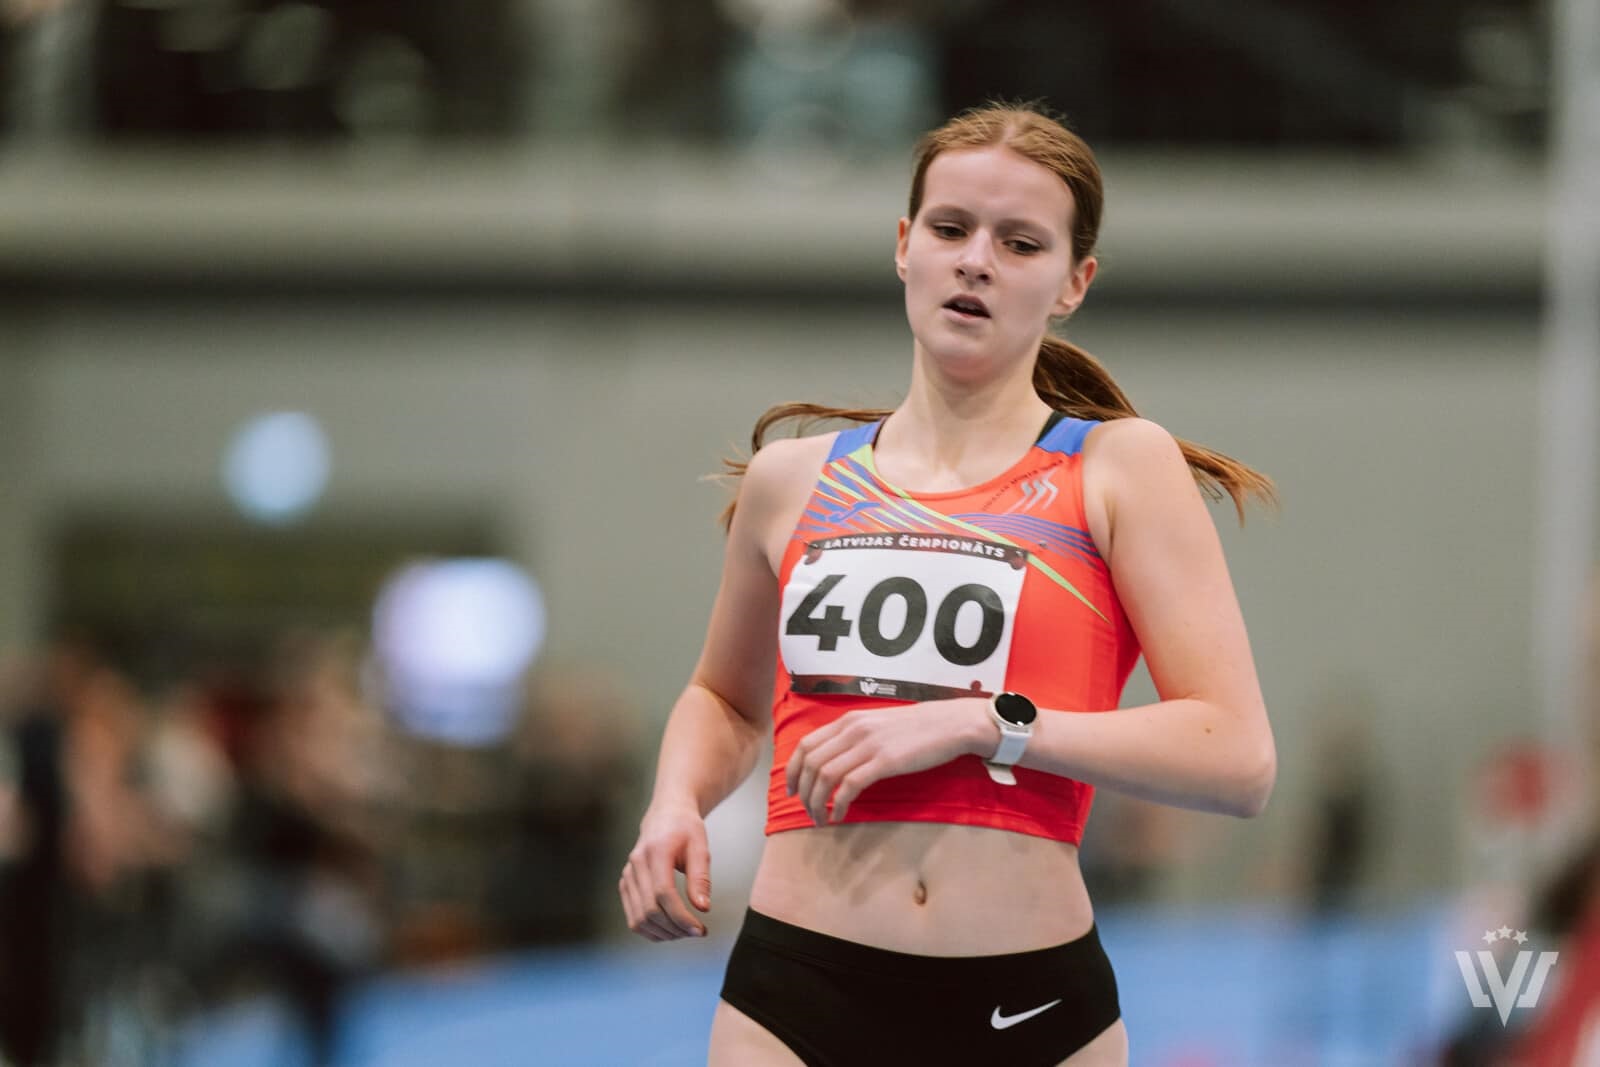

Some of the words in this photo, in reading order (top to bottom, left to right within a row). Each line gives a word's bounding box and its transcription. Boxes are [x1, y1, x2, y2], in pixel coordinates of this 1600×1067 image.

[823, 536, 894, 549] LATVIJAS
[898, 534, 1006, 558] ČEMPIONĀTS
[785, 574, 1005, 666] 400
